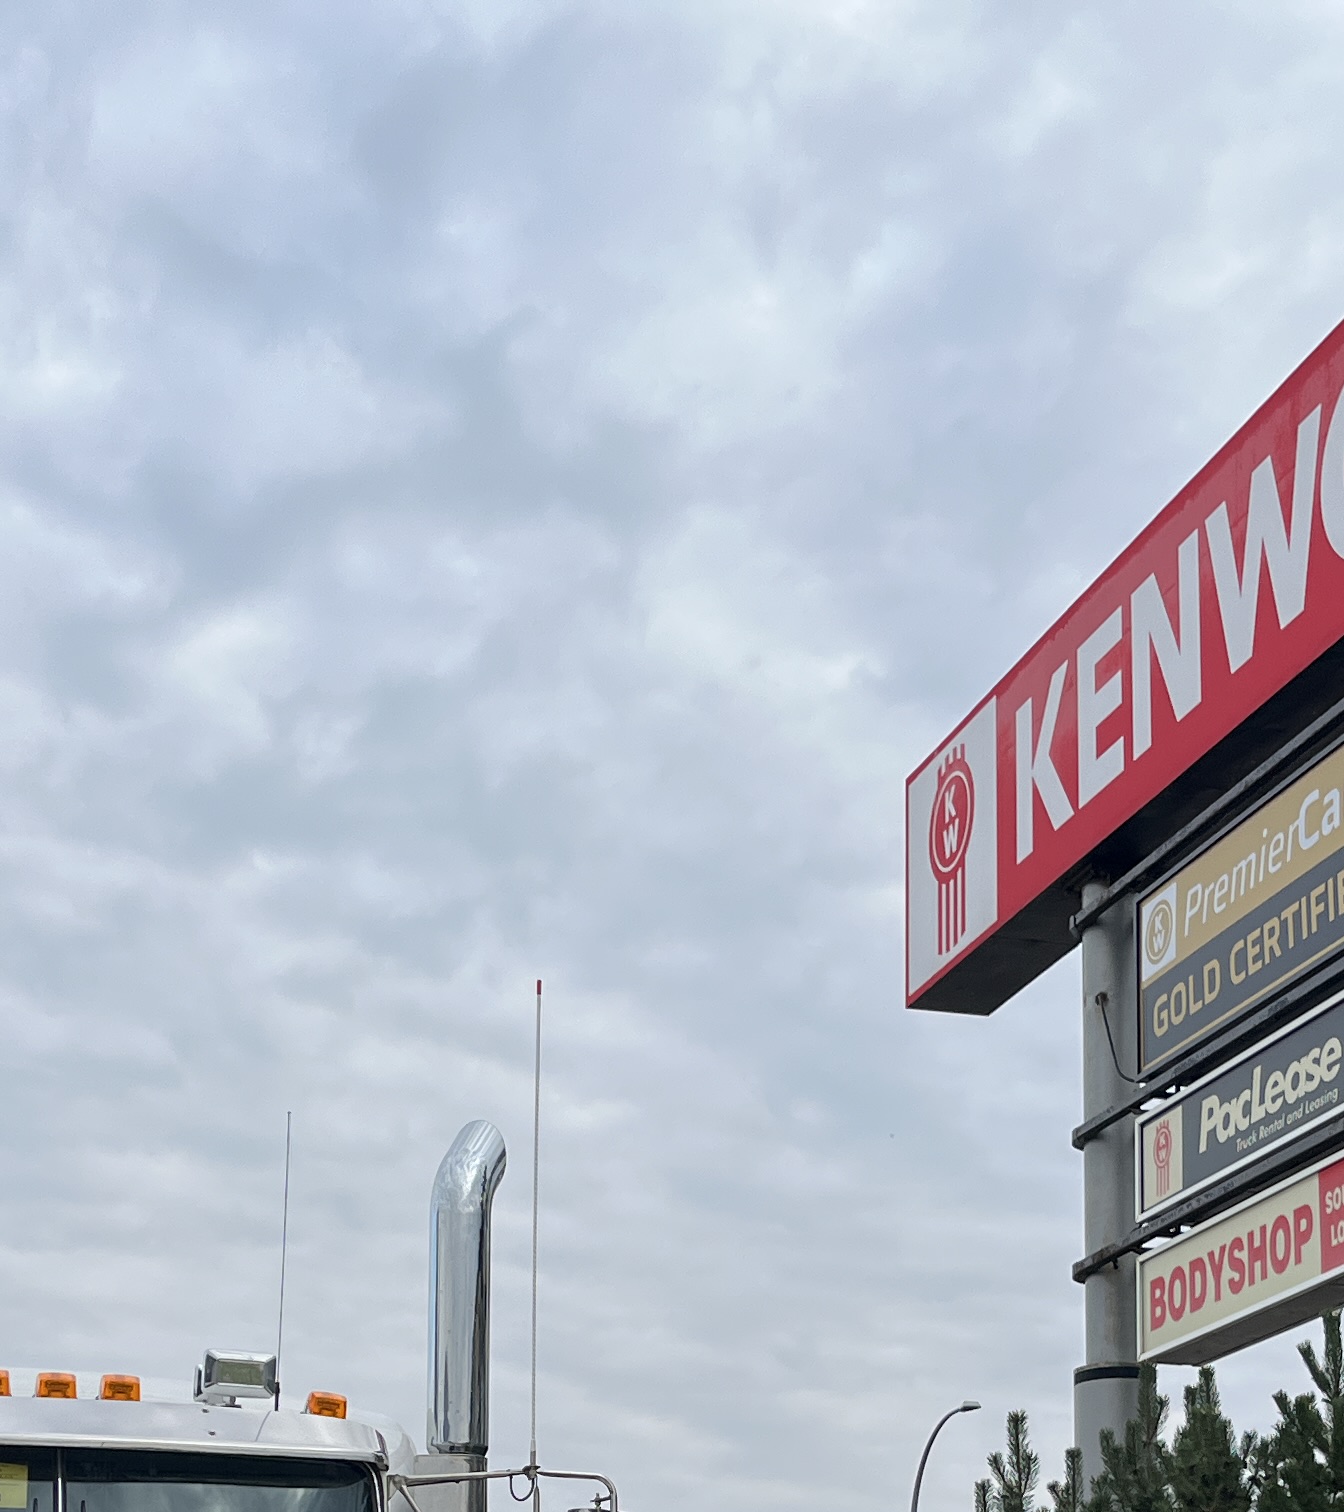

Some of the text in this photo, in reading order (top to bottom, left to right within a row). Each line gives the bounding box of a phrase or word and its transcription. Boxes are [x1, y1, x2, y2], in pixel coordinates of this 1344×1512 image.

[1152, 958, 1222, 1038] GOLD
[1198, 1036, 1343, 1154] PacLease
[1236, 1087, 1339, 1153] Truck Rental and Leasing
[1149, 1203, 1314, 1333] BODYSHOP
